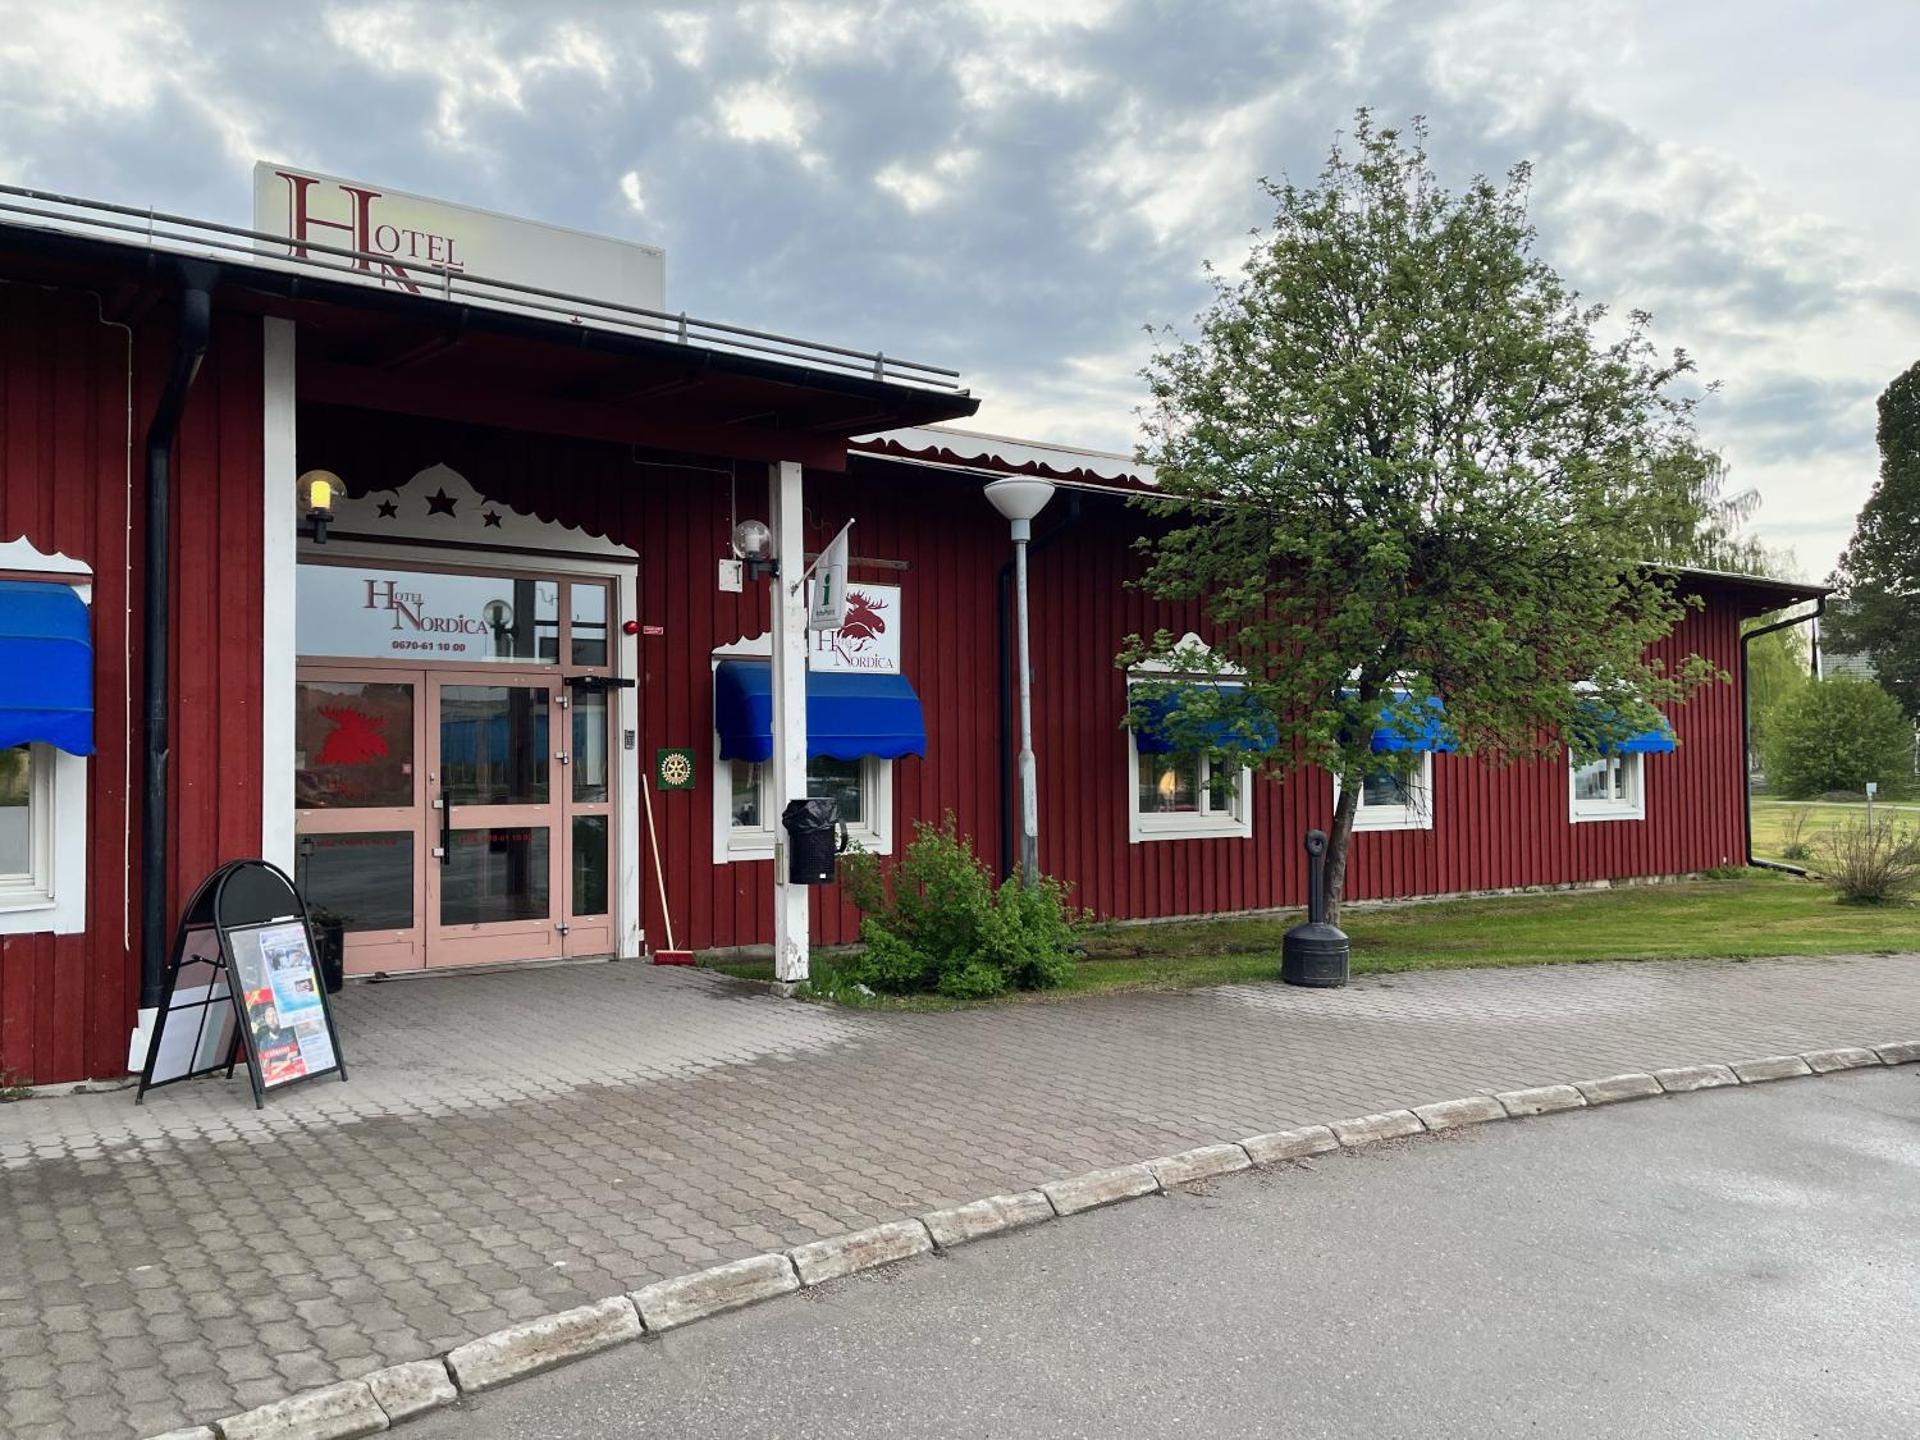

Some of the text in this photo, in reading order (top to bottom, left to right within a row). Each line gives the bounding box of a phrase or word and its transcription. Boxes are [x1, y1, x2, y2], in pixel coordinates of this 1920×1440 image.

[275, 171, 464, 271] HOTEL
[363, 580, 423, 609] HOTEL
[392, 601, 488, 634] NORDICA
[392, 640, 434, 650] 0670-61
[438, 642, 450, 651] 10
[833, 645, 894, 669] NORDICA
